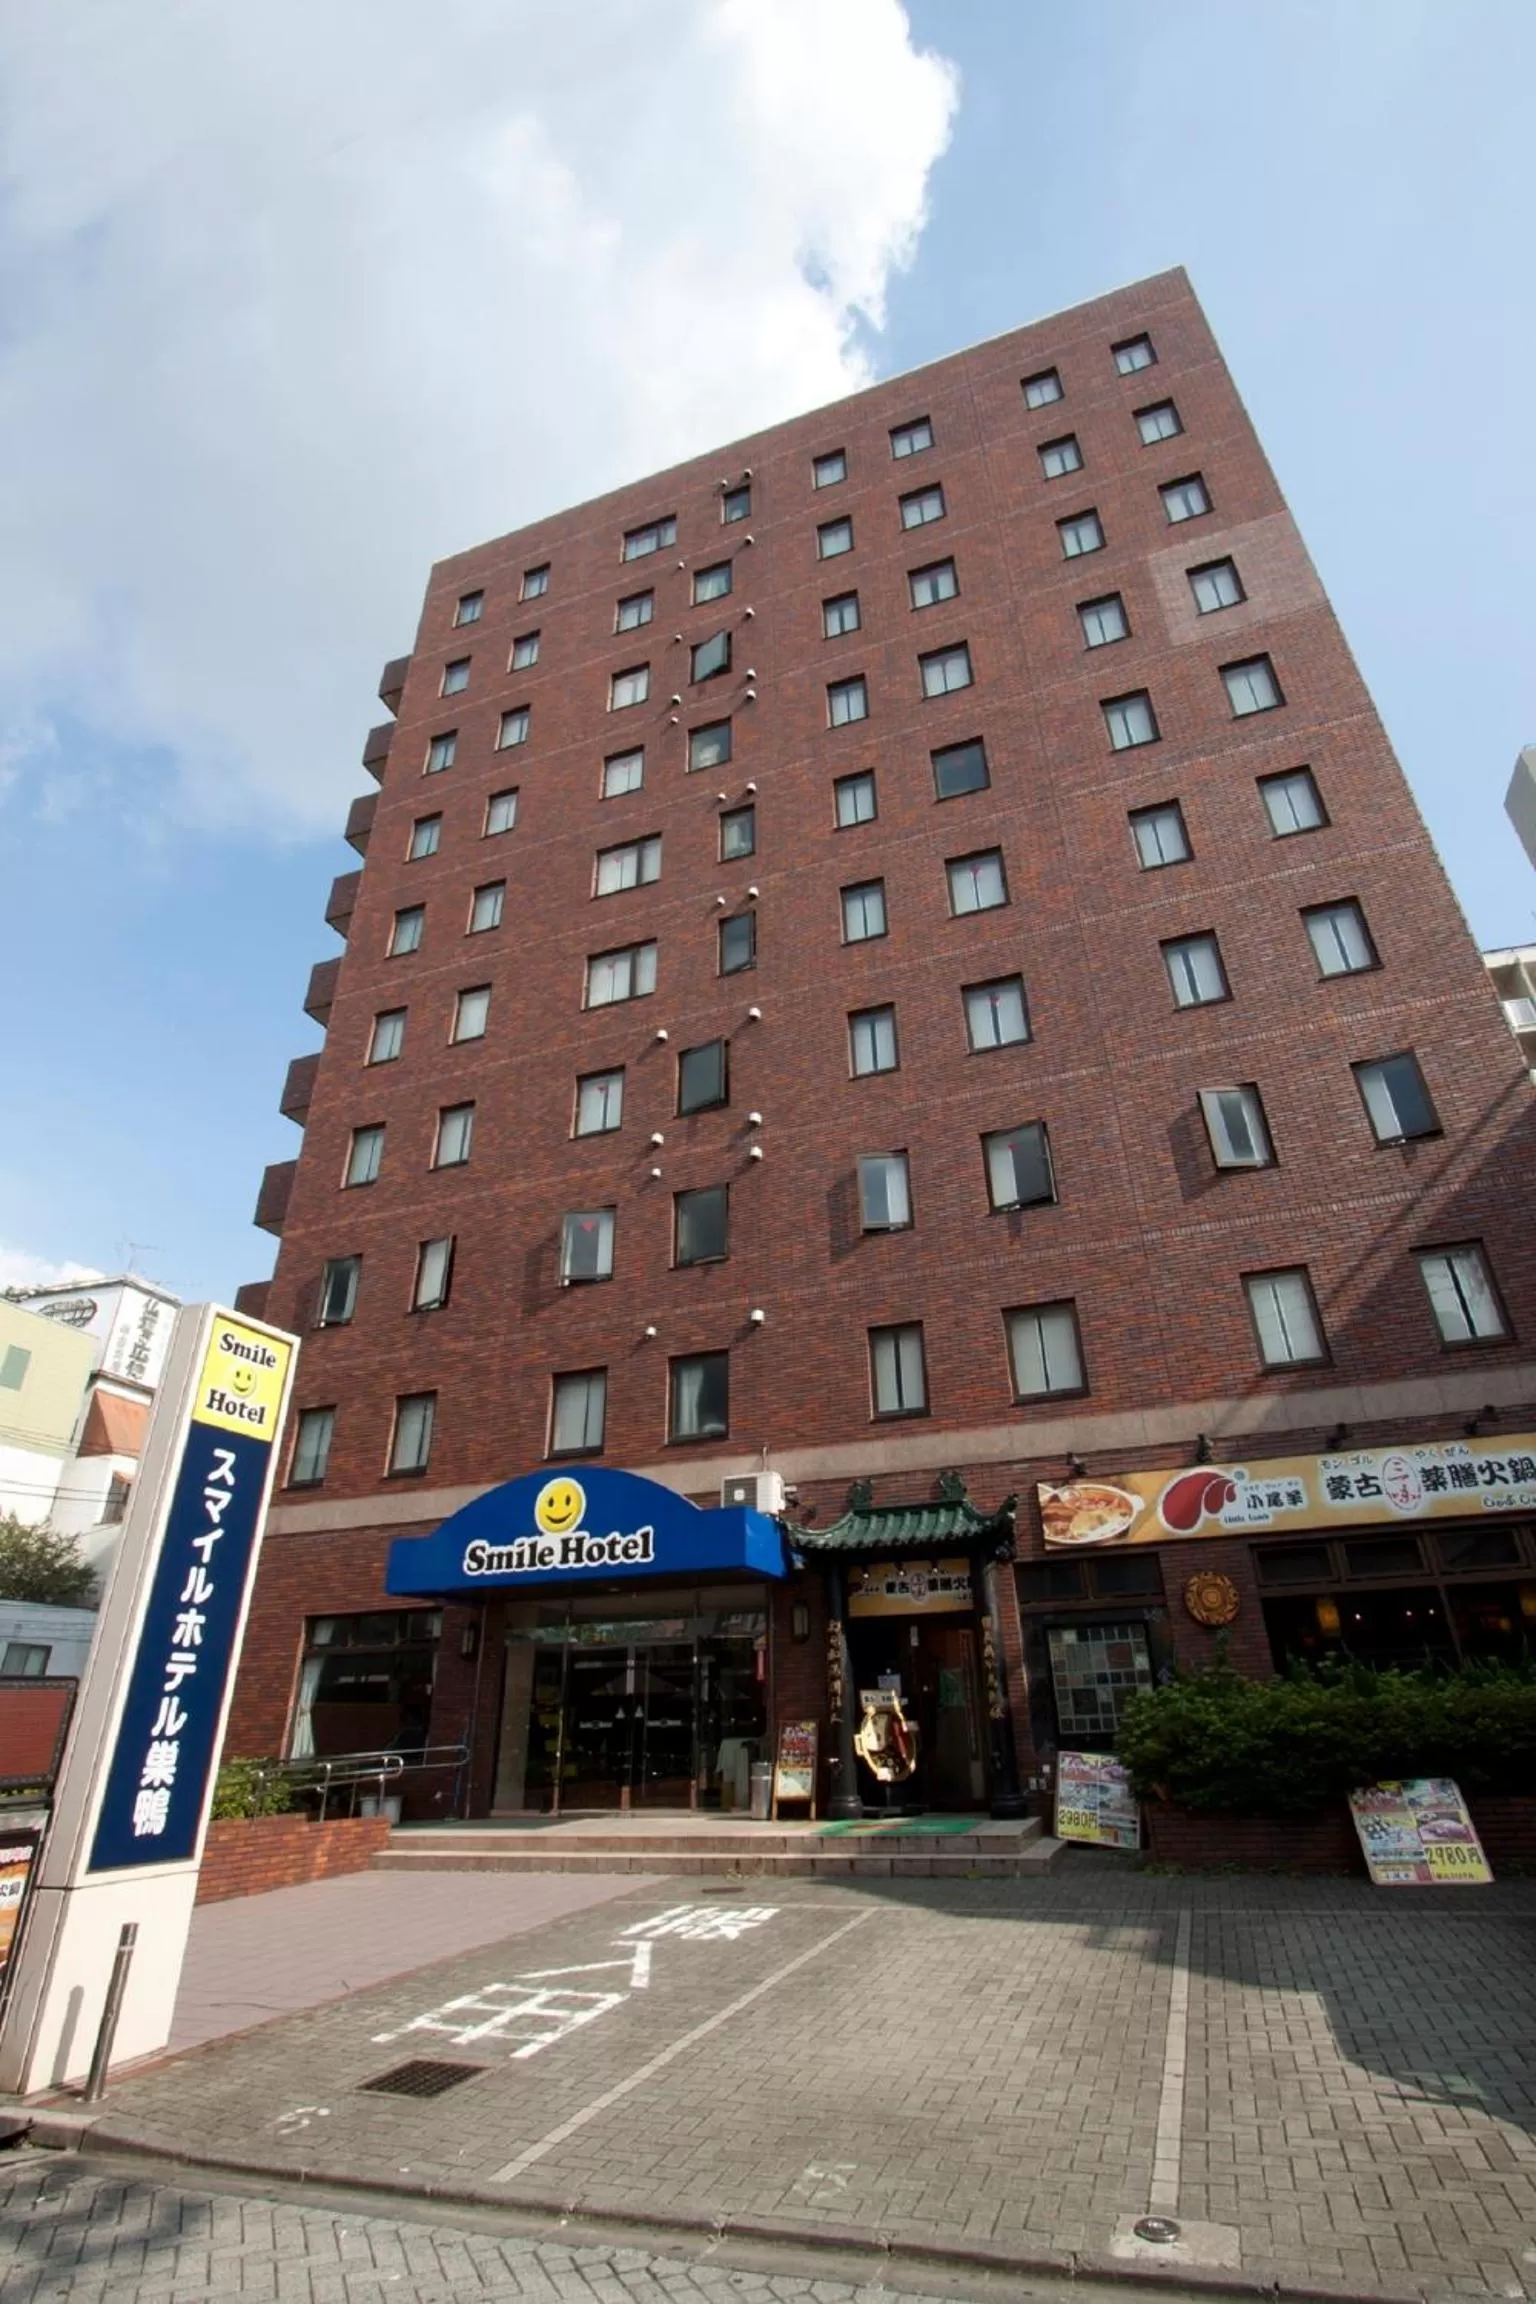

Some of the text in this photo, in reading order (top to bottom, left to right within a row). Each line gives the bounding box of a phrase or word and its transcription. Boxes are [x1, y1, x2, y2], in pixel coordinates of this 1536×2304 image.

[220, 1333, 277, 1368] Smile
[206, 1389, 266, 1424] Hotel
[466, 1530, 652, 1573] Smile Hotel
[132, 1448, 237, 1837] スマイルホテル巣鴨
